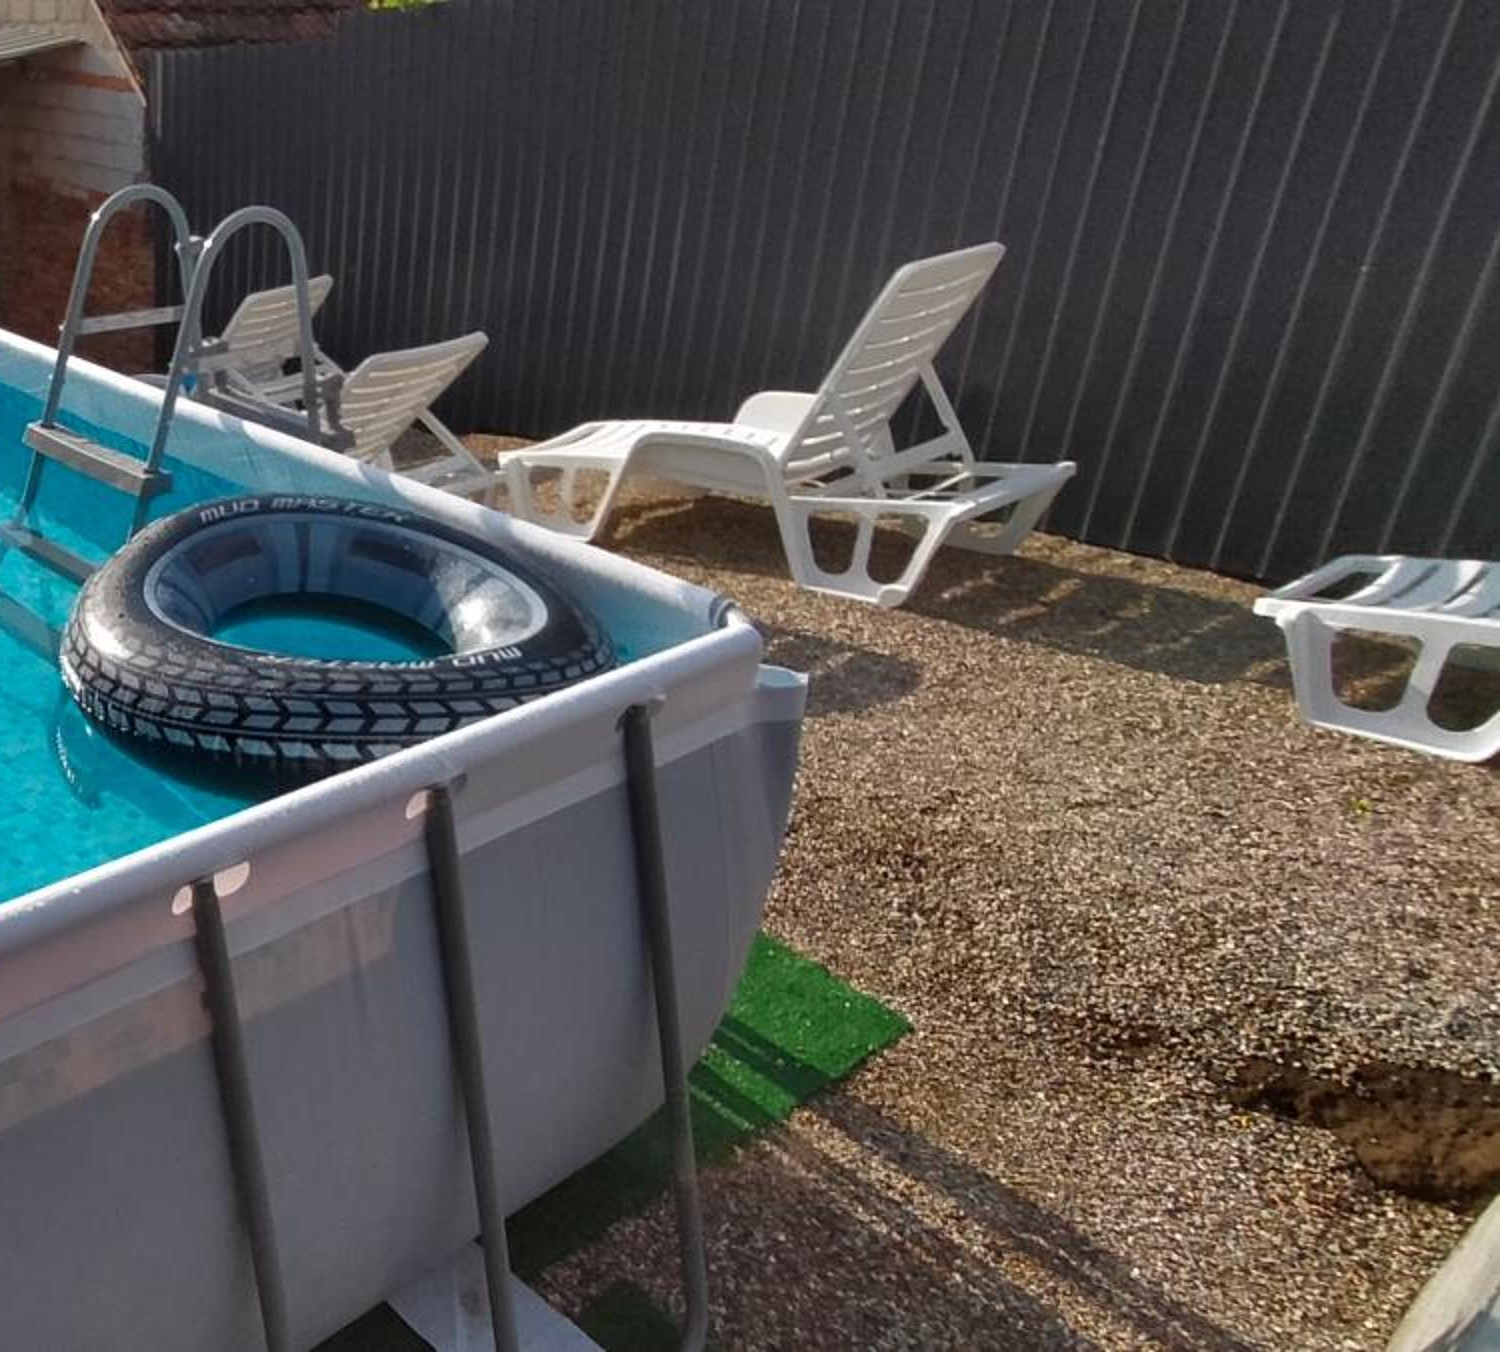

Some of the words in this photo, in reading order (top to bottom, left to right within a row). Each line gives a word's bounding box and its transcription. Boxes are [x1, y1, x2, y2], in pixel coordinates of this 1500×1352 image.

[199, 498, 260, 525] MUD
[270, 496, 411, 523] MASTER
[451, 645, 523, 668] MUD
